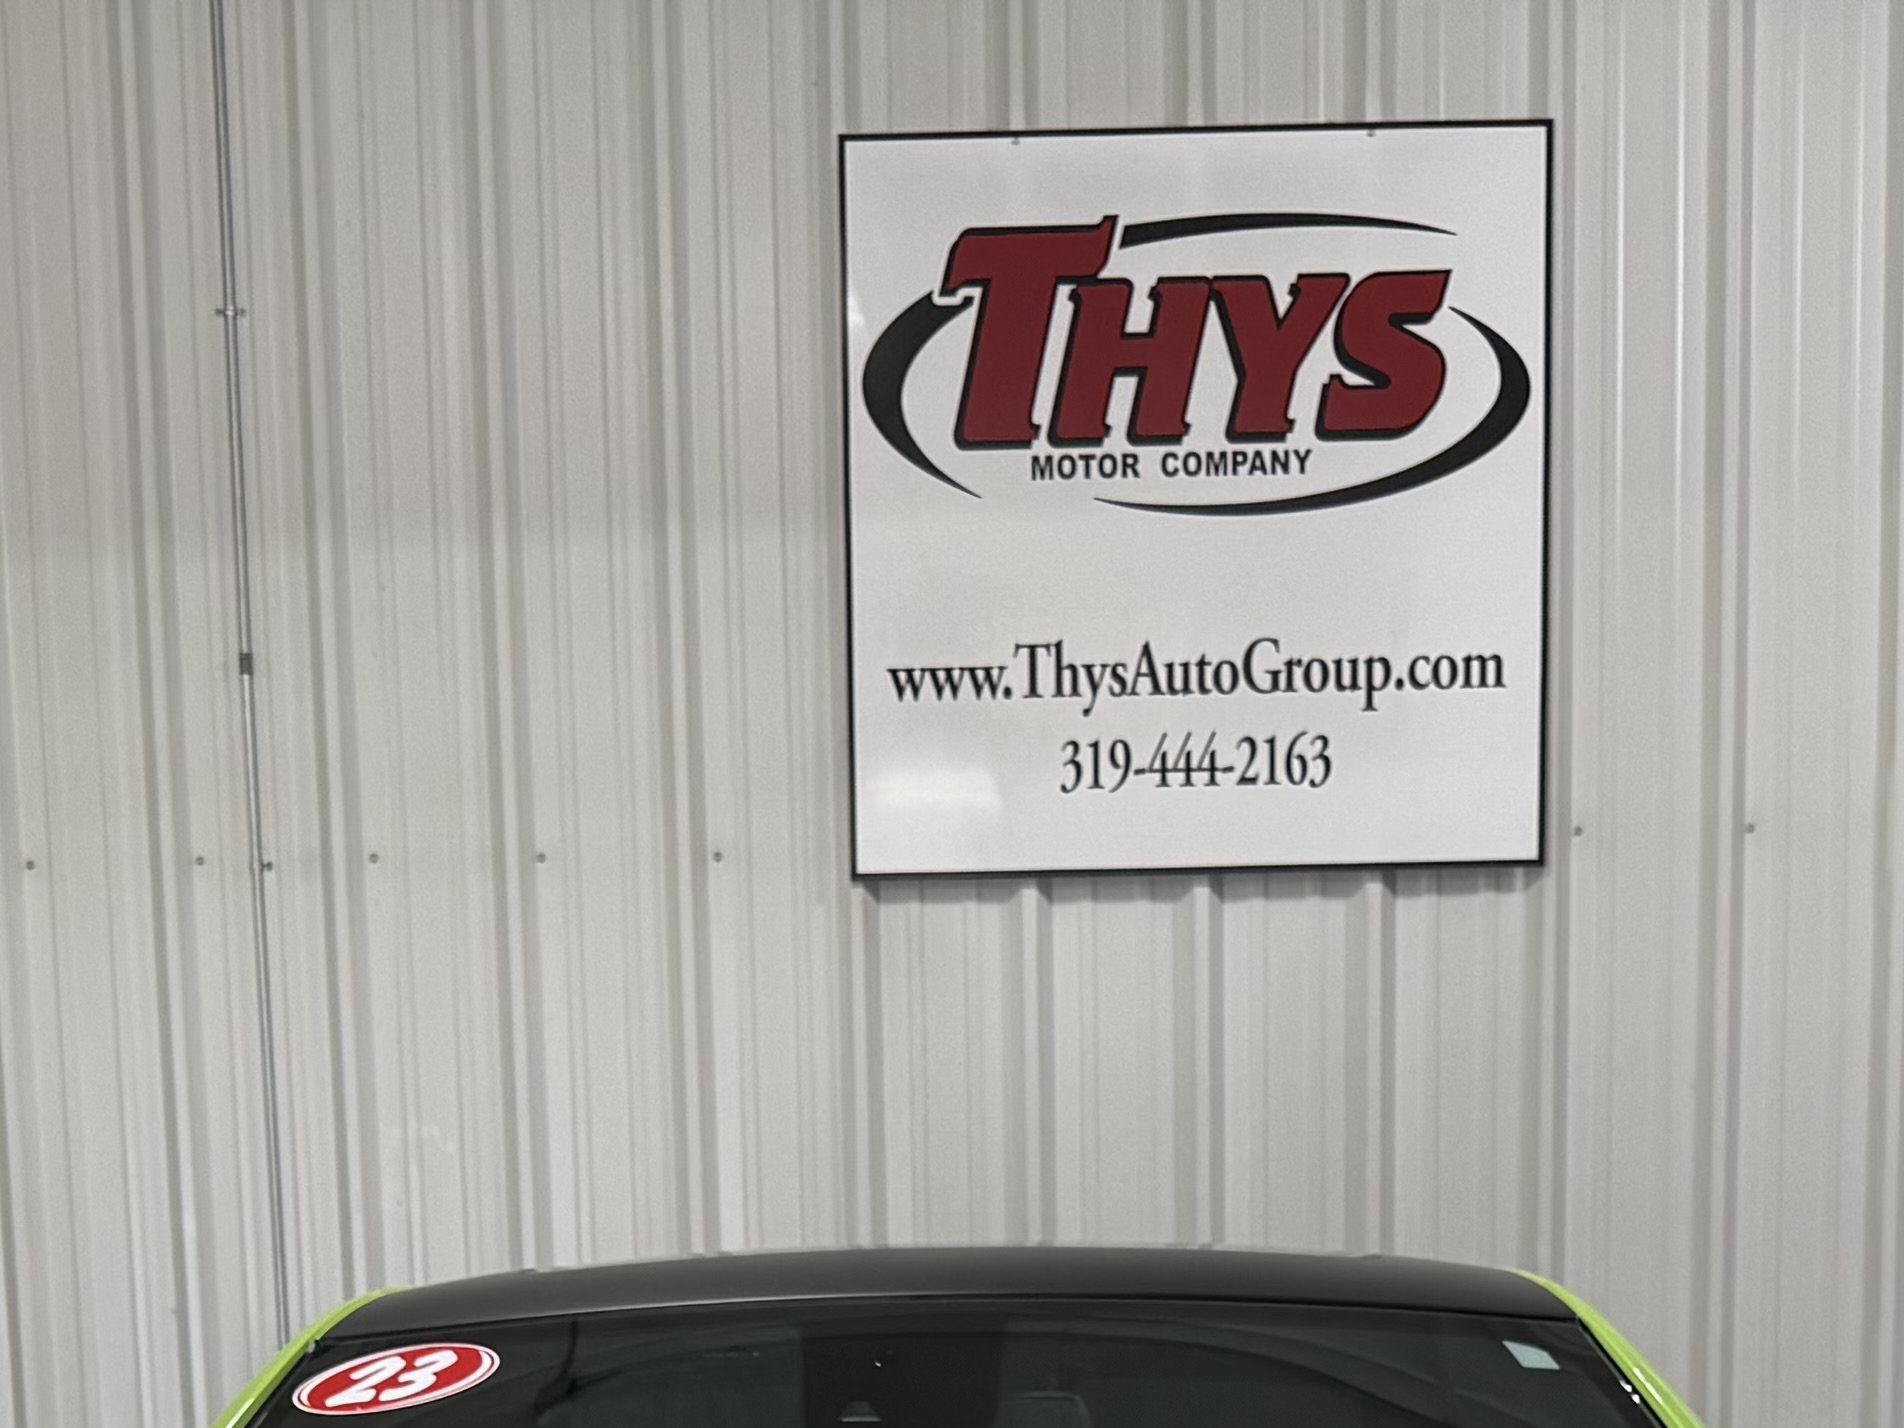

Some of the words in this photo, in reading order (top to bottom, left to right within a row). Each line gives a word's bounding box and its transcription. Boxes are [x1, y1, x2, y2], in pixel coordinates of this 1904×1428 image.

[942, 214, 1452, 451] THYS
[1030, 453, 1141, 481] MOTOR
[1160, 449, 1313, 478] COMPANY
[888, 638, 1507, 718] www.ThysAutoGroup.com
[1060, 730, 1333, 794] 319-444-2163
[325, 1349, 458, 1408] 23
